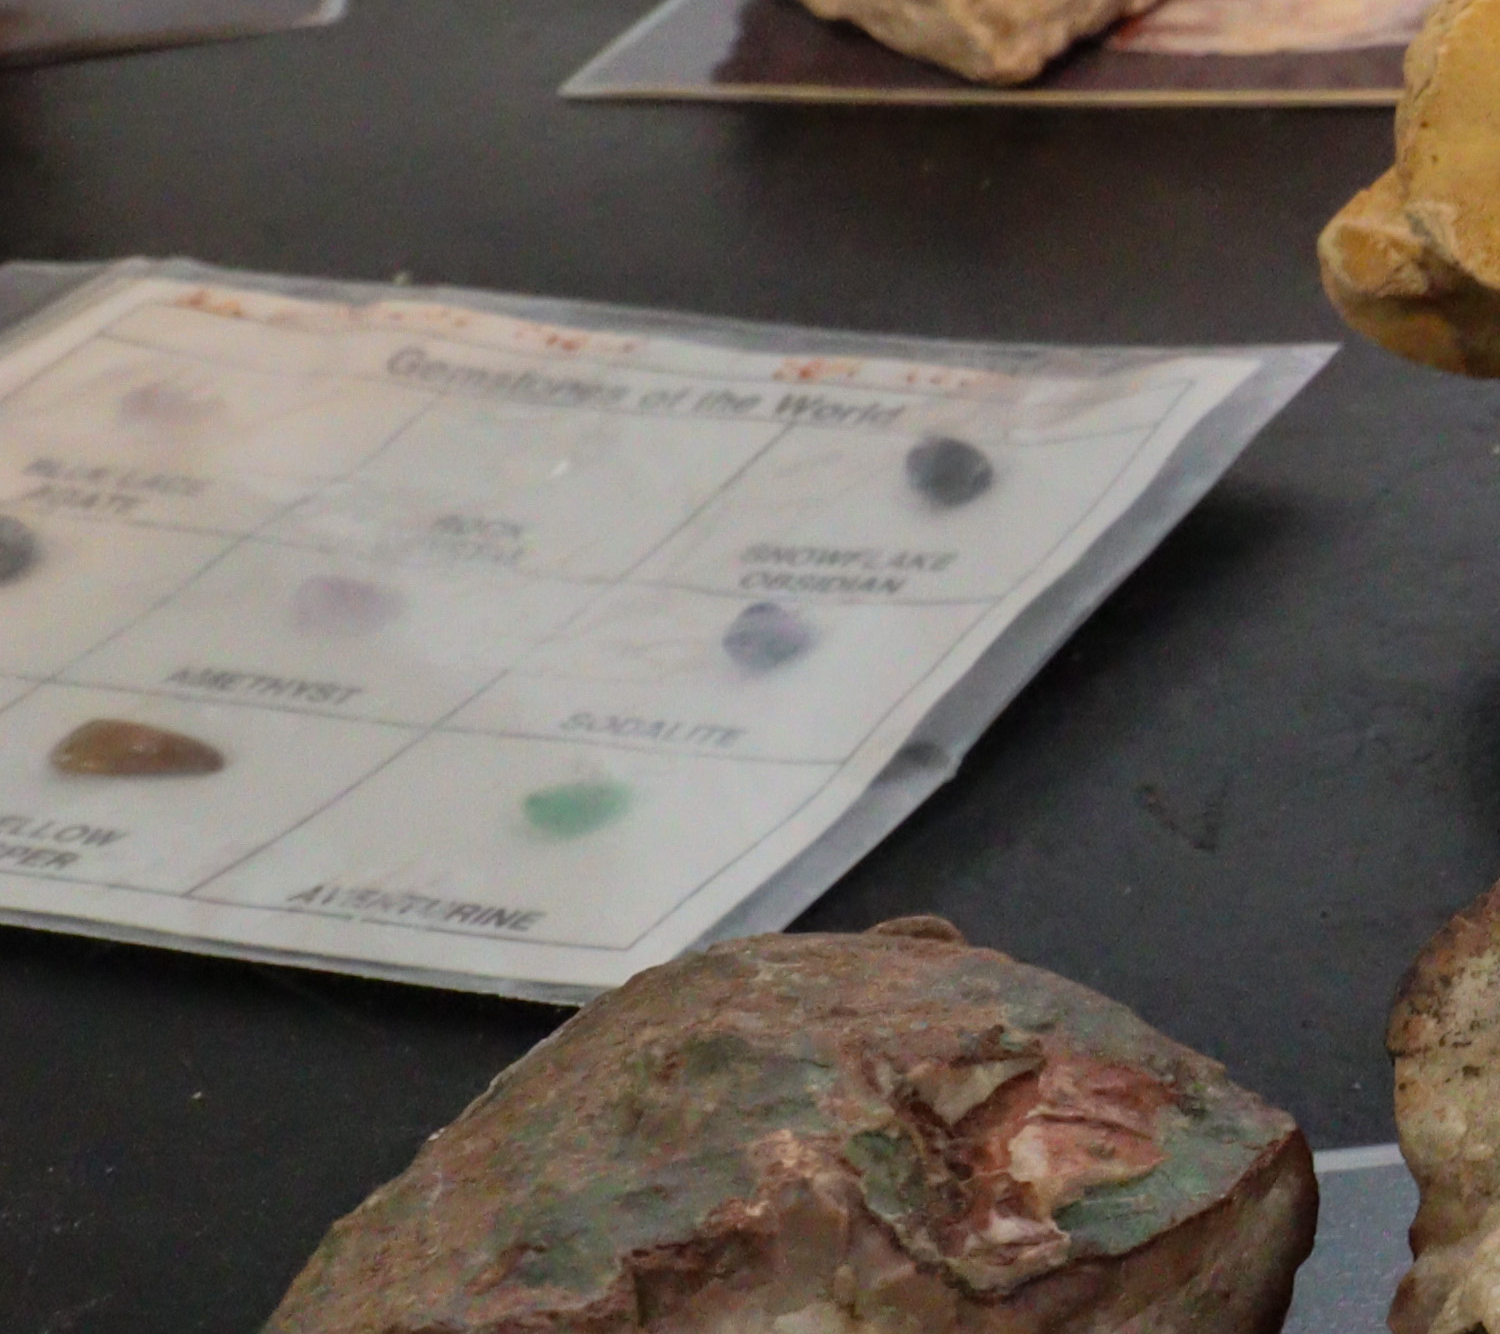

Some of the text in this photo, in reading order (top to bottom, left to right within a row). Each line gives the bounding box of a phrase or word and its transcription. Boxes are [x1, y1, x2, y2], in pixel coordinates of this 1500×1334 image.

[387, 347, 908, 425] Gemstones of the World
[164, 664, 364, 706] AMETHYST
[559, 709, 747, 748] SODALITE
[285, 882, 548, 933] AVENTURINE
